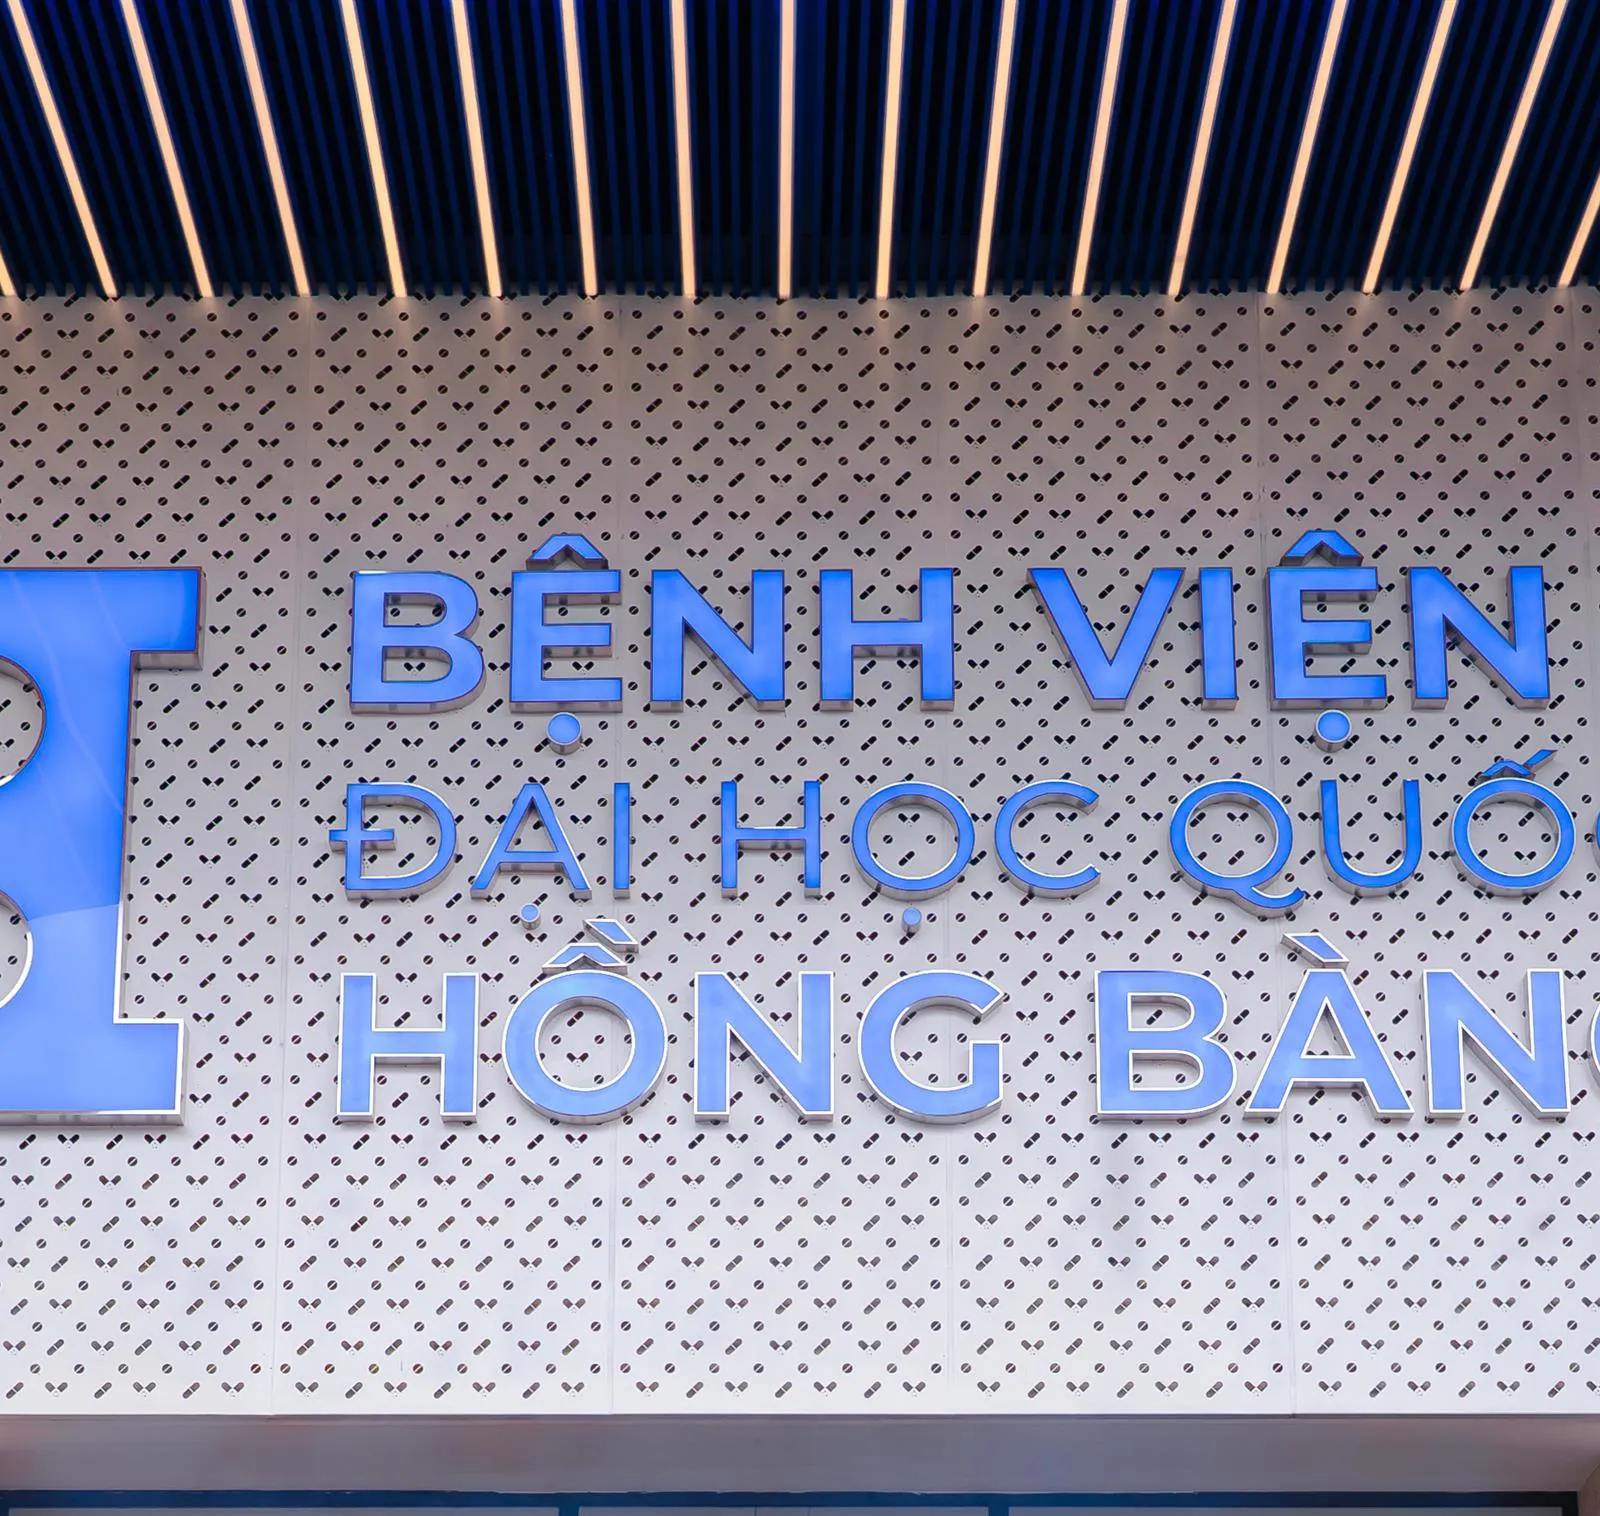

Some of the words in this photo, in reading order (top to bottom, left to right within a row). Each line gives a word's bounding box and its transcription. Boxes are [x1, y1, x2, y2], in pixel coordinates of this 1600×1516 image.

[349, 533, 956, 754] BỆNH
[1026, 529, 1551, 752] VIỆN
[328, 780, 631, 930] ĐẠI
[720, 779, 1102, 936] HỌC
[335, 918, 1004, 1124] HỒNG
